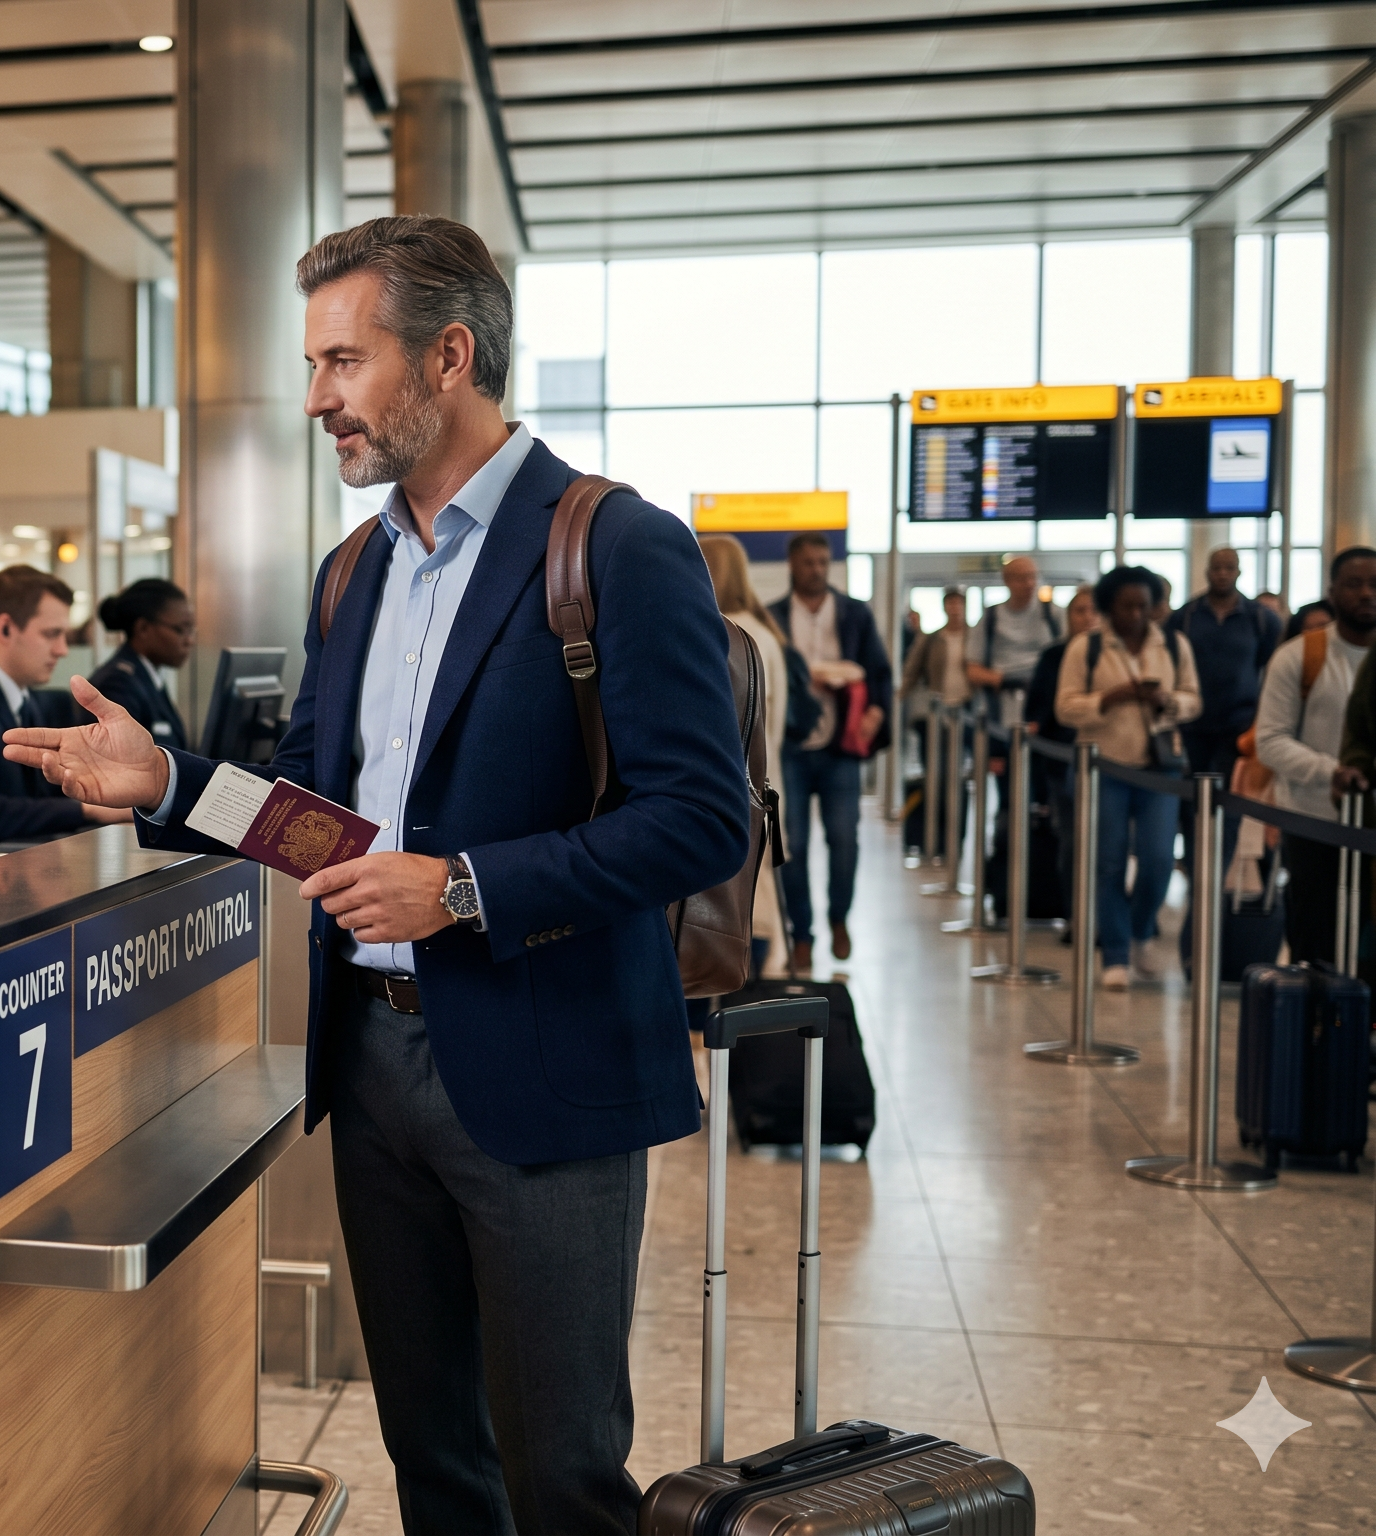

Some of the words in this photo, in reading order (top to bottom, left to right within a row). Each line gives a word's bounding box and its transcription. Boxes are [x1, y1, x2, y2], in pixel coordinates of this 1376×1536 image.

[946, 392, 995, 411] GATE
[1000, 390, 1048, 411] INFO
[1171, 386, 1267, 406] ARRIVALS
[86, 918, 180, 1012] PASSPORT
[184, 889, 253, 962] CONTROL
[19, 1022, 47, 1150] 7
